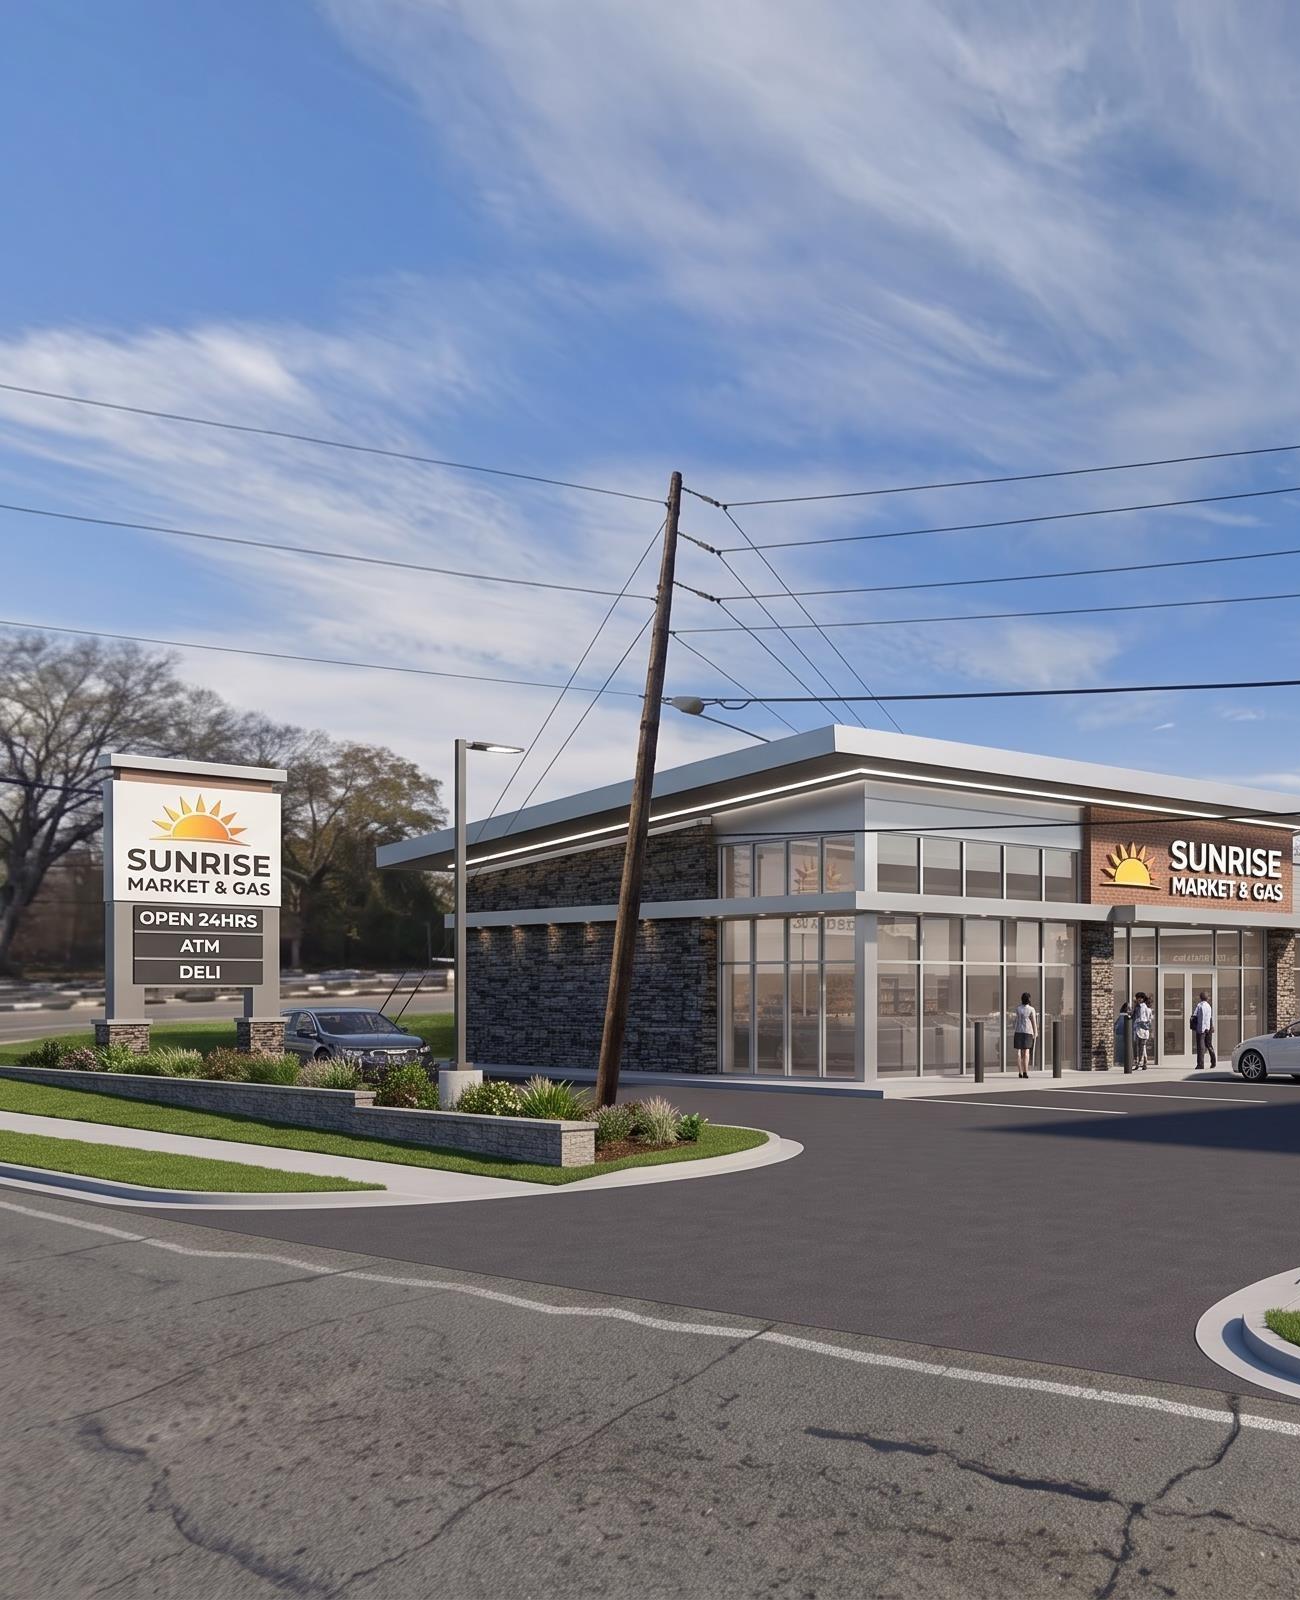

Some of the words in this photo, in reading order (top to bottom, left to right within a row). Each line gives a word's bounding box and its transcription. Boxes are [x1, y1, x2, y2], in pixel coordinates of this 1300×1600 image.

[127, 848, 271, 877] SUNRISE
[1171, 840, 1282, 878] SUNRISE
[127, 877, 210, 894] MARKET
[214, 881, 227, 894] &
[233, 881, 271, 896] GAS
[1172, 877, 1236, 897] MARKET
[1238, 882, 1249, 899] &
[1253, 882, 1283, 901] GAS
[139, 910, 194, 926] OPEN
[198, 912, 258, 928] 24HRS
[179, 939, 220, 953] ATM
[179, 965, 221, 979] DELI
